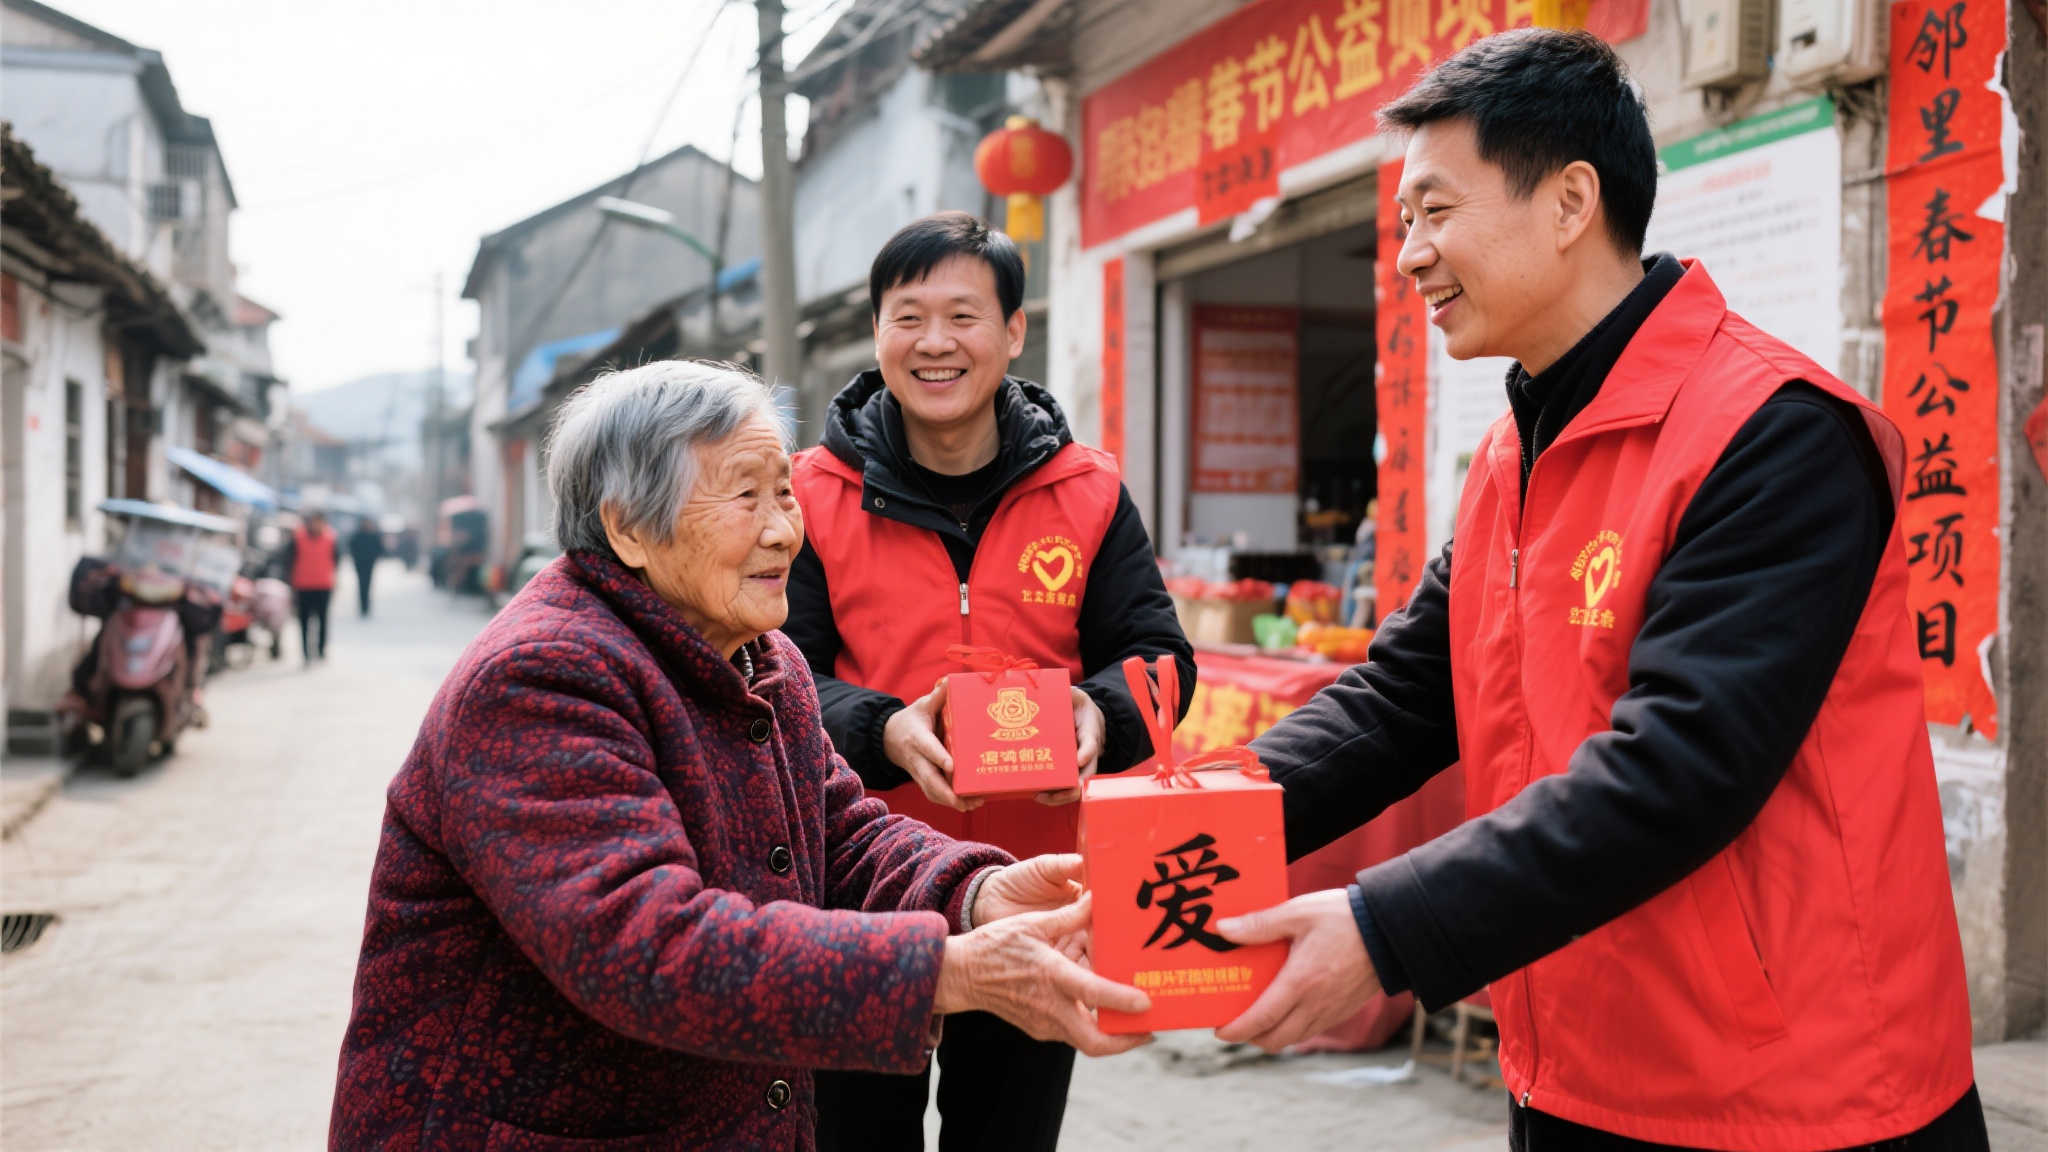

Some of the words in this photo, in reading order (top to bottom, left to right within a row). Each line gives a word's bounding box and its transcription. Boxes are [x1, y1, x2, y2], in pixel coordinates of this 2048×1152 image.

[1906, 2, 1973, 667] 邻里春节公益项目
[1136, 833, 1241, 952] 爱
